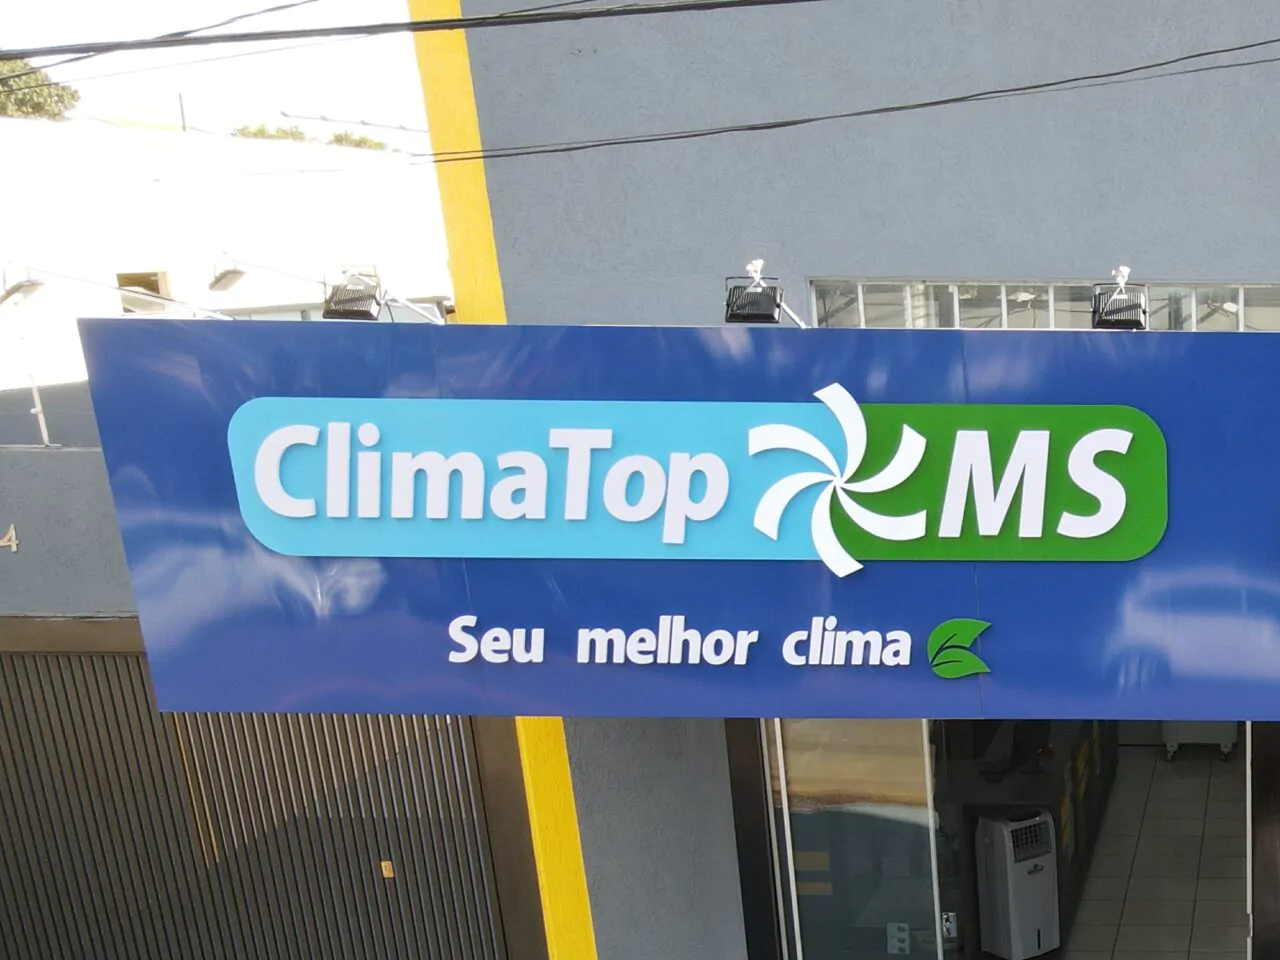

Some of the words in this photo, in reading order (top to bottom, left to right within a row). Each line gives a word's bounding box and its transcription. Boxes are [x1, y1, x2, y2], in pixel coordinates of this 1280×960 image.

[254, 421, 730, 545] ClimaTop
[938, 428, 1134, 539] MS
[448, 615, 544, 664] Seu
[577, 615, 759, 666] melhor
[782, 615, 913, 667] clima
